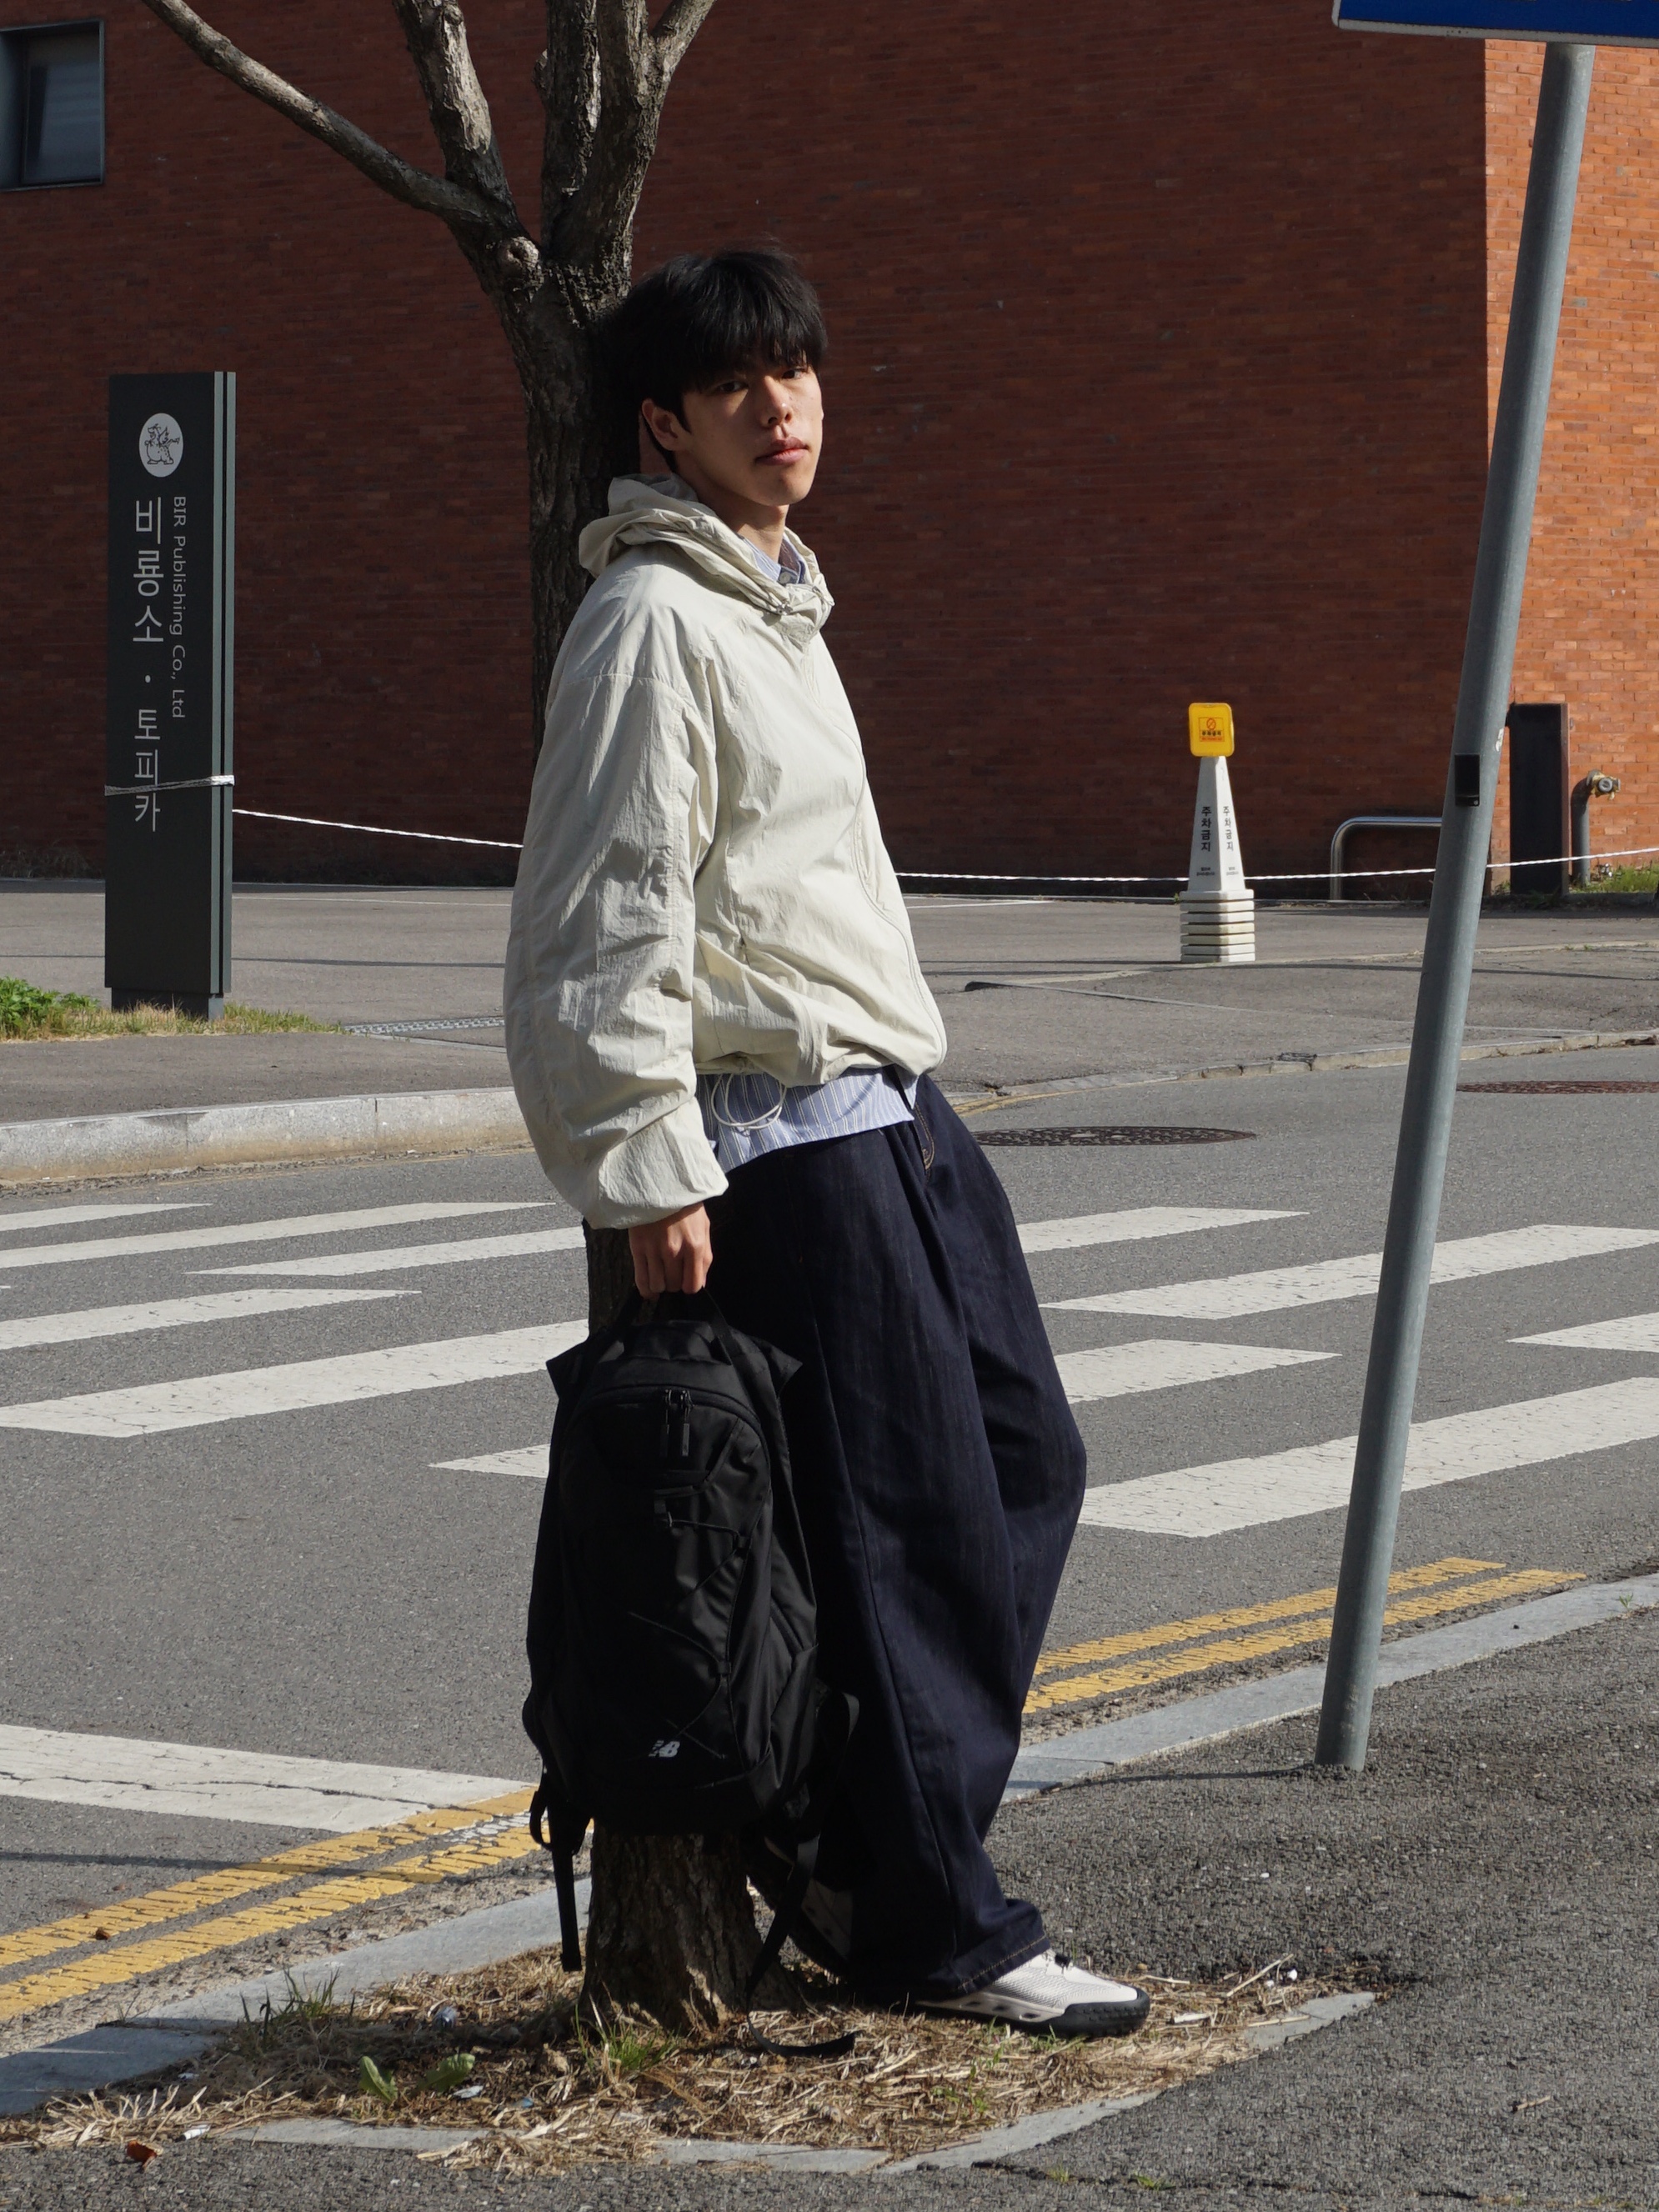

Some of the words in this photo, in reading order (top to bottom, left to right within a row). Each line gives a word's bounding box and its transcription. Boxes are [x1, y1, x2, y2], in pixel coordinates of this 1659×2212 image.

[173, 496, 187, 527] BIR
[133, 497, 164, 642] 비룡소
[169, 535, 187, 636] Publishing
[170, 644, 186, 680] Co.,
[172, 689, 186, 718] Ltd
[134, 709, 161, 832] 토피카
[1200, 806, 1212, 852] 주차금지
[1223, 805, 1234, 851] 주차금지
